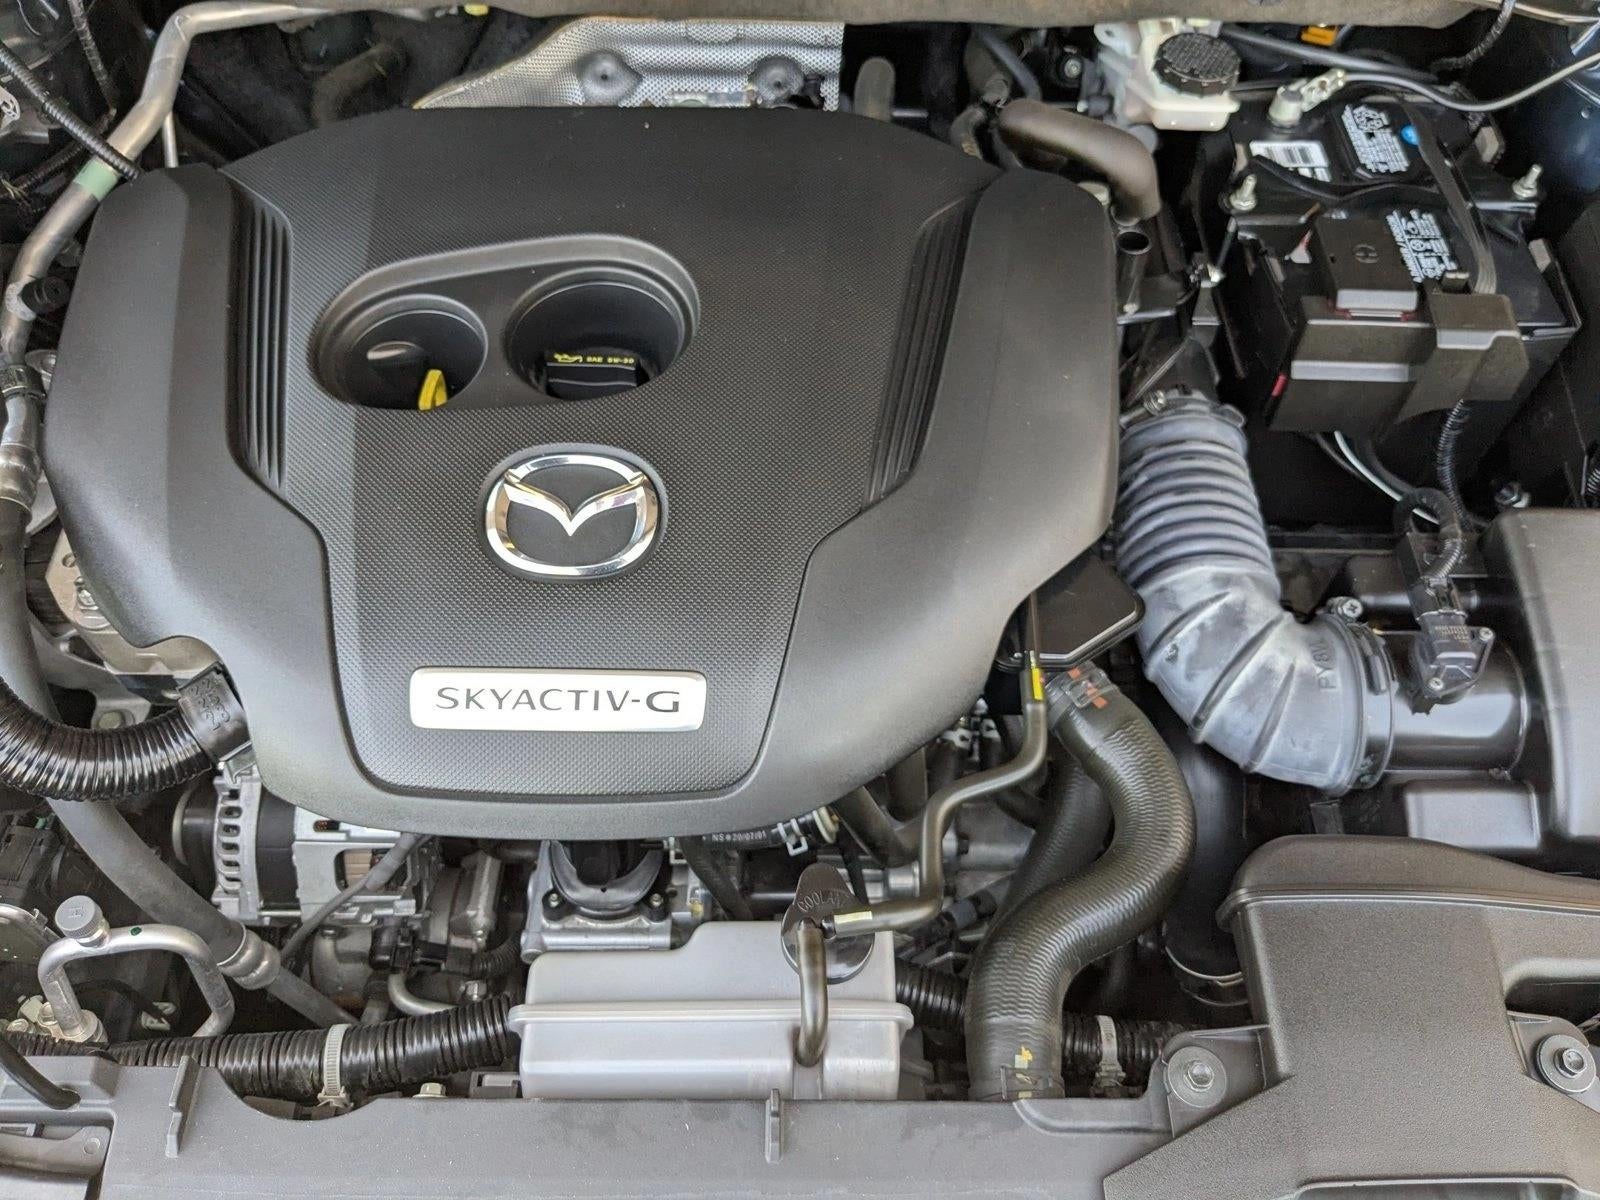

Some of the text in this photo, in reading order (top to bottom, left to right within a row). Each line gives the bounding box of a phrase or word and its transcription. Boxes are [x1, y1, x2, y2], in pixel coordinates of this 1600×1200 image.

[585, 355, 636, 365] SAE 5W-30
[434, 686, 681, 713] SKYACTIV-G
